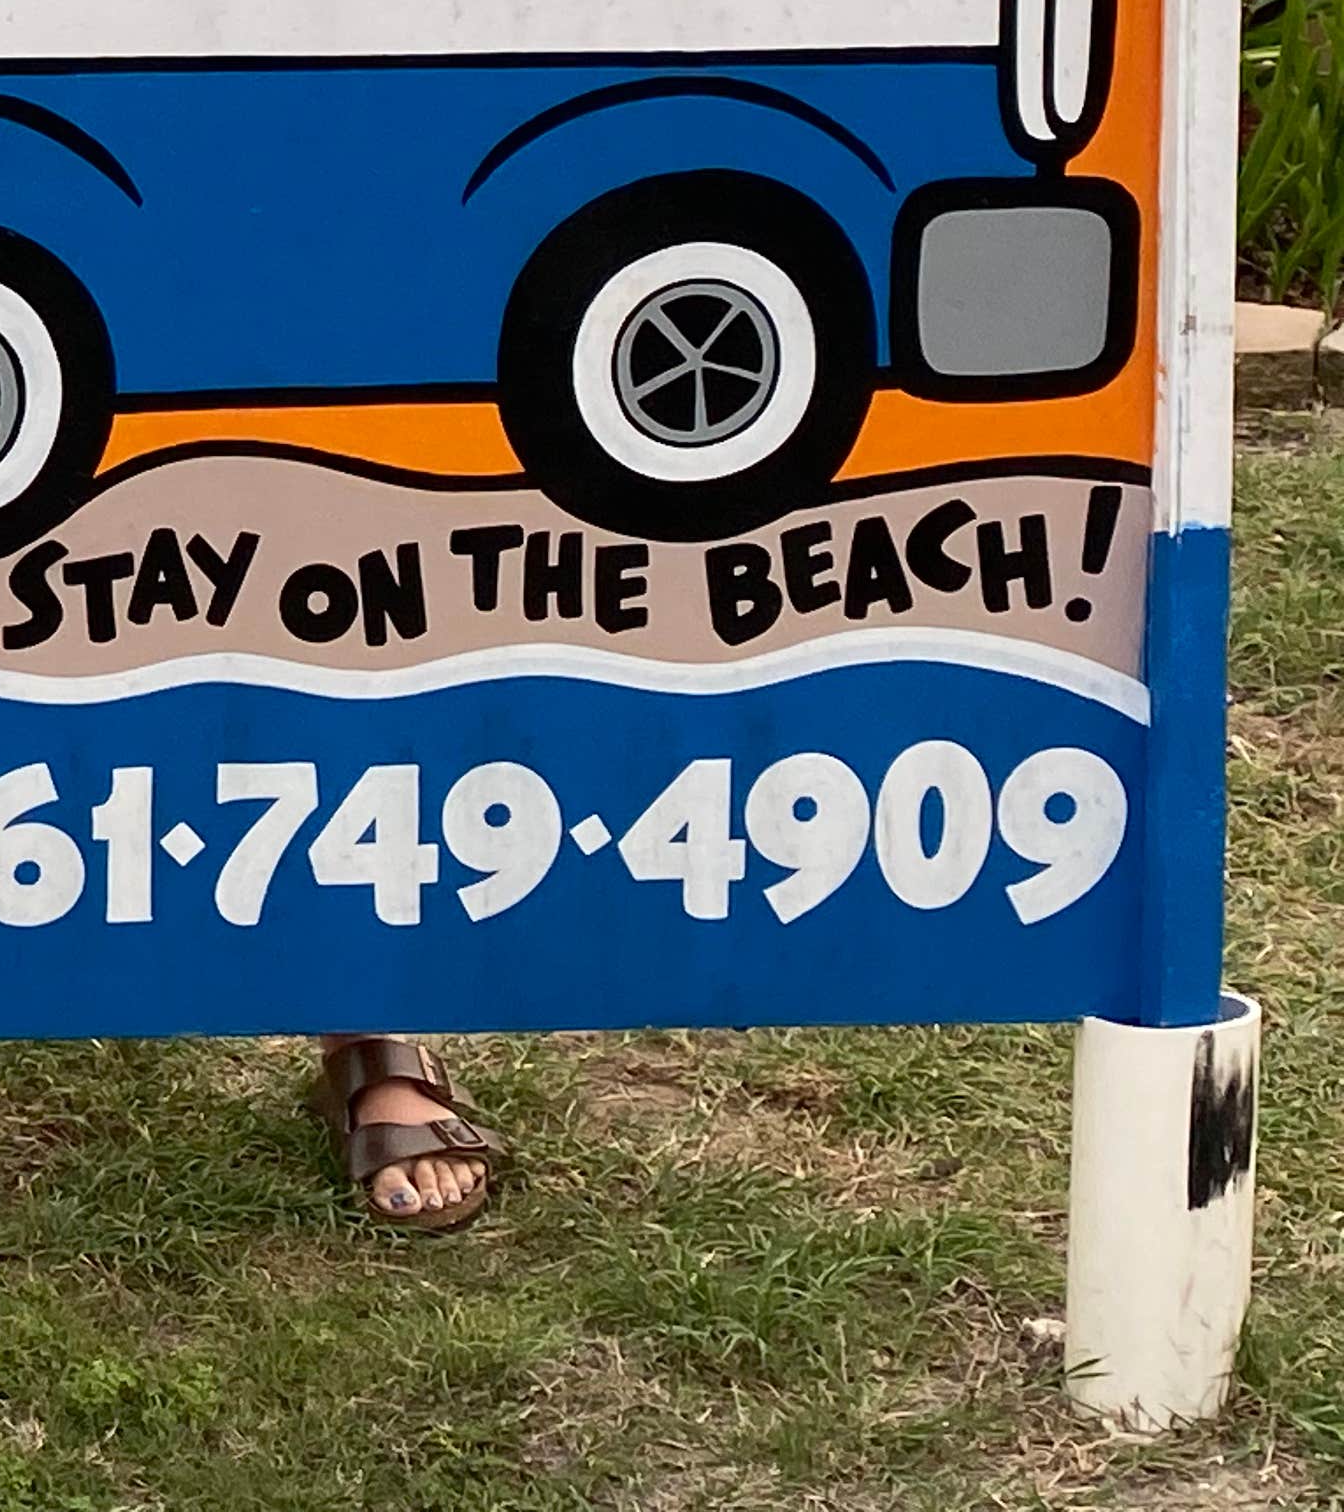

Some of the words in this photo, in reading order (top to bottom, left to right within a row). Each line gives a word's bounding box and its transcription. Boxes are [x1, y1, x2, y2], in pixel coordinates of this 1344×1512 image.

[2, 528, 261, 650] STAY
[278, 542, 428, 647] ON
[450, 525, 650, 634] THE
[705, 486, 1123, 646] BEACH!
